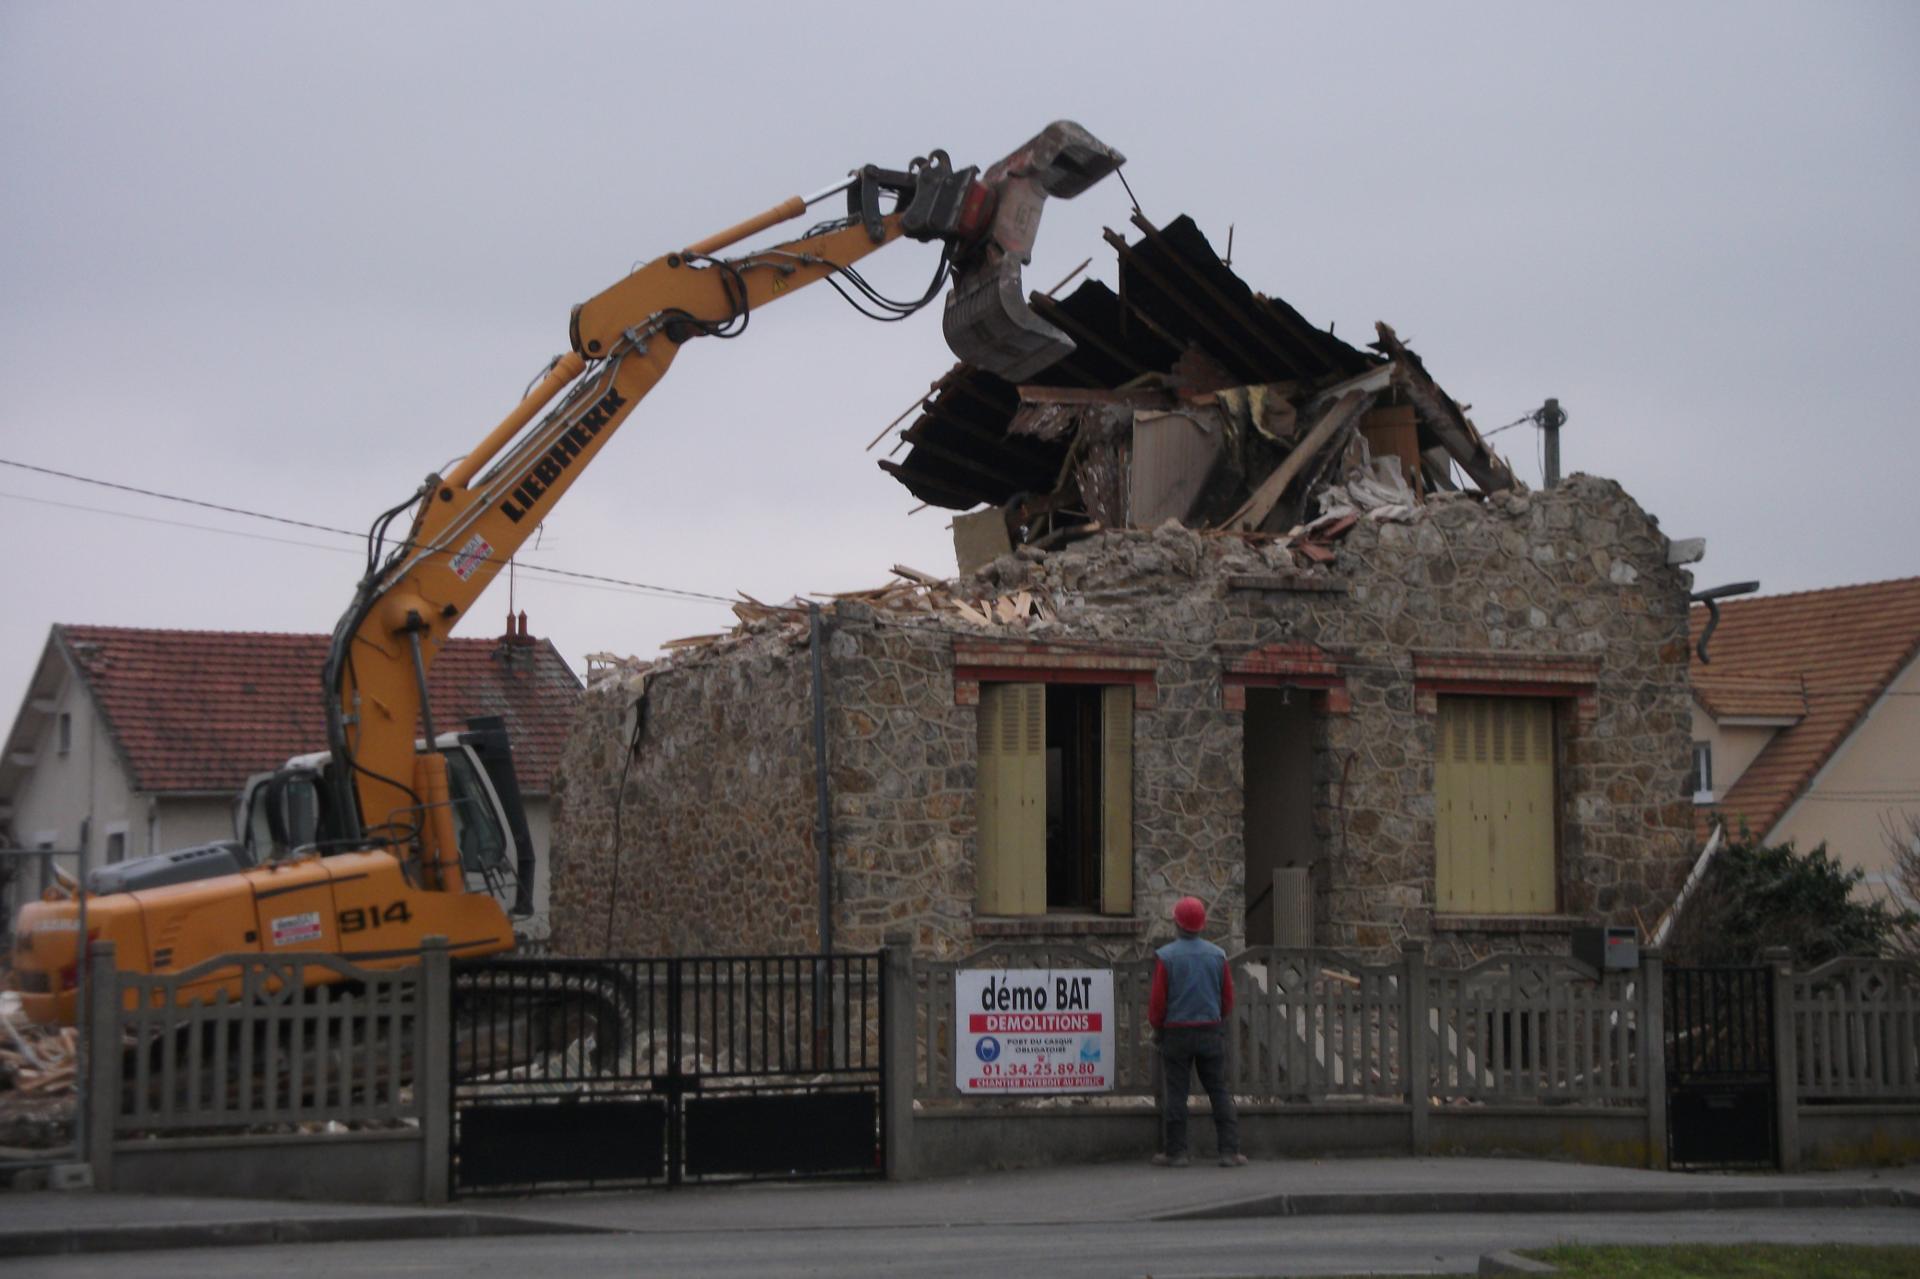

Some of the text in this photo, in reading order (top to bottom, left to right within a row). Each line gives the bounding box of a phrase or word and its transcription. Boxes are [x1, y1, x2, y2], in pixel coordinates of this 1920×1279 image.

[500, 387, 627, 524] LIEBHERR
[340, 900, 412, 933] 914
[981, 975, 1092, 1011] démo BAT
[986, 1015, 1089, 1031] DEMOLITIONS
[1044, 1038, 1073, 1046] CASQUE
